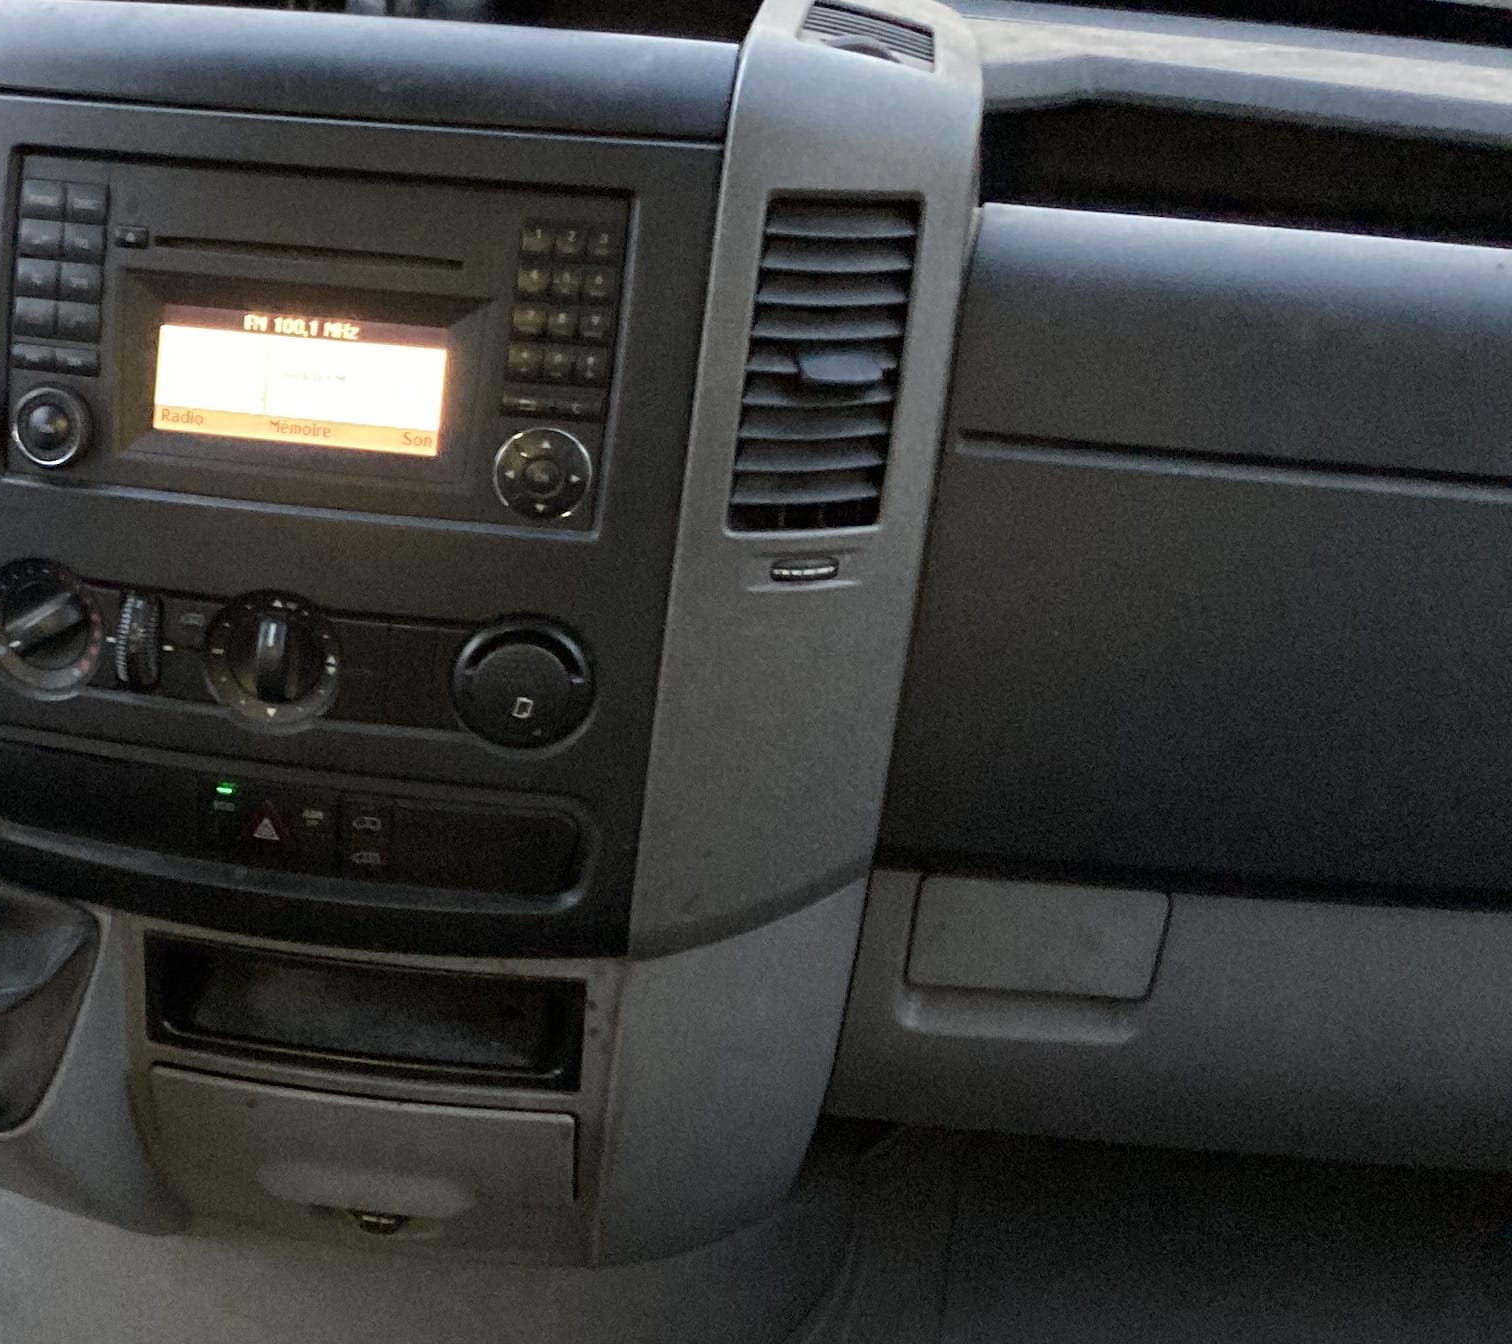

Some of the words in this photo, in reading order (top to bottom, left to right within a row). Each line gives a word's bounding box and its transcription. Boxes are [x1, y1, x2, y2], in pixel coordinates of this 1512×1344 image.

[243, 314, 268, 332] FM
[323, 321, 361, 341] MHz
[160, 408, 204, 426] Radio
[402, 431, 433, 449] Son
